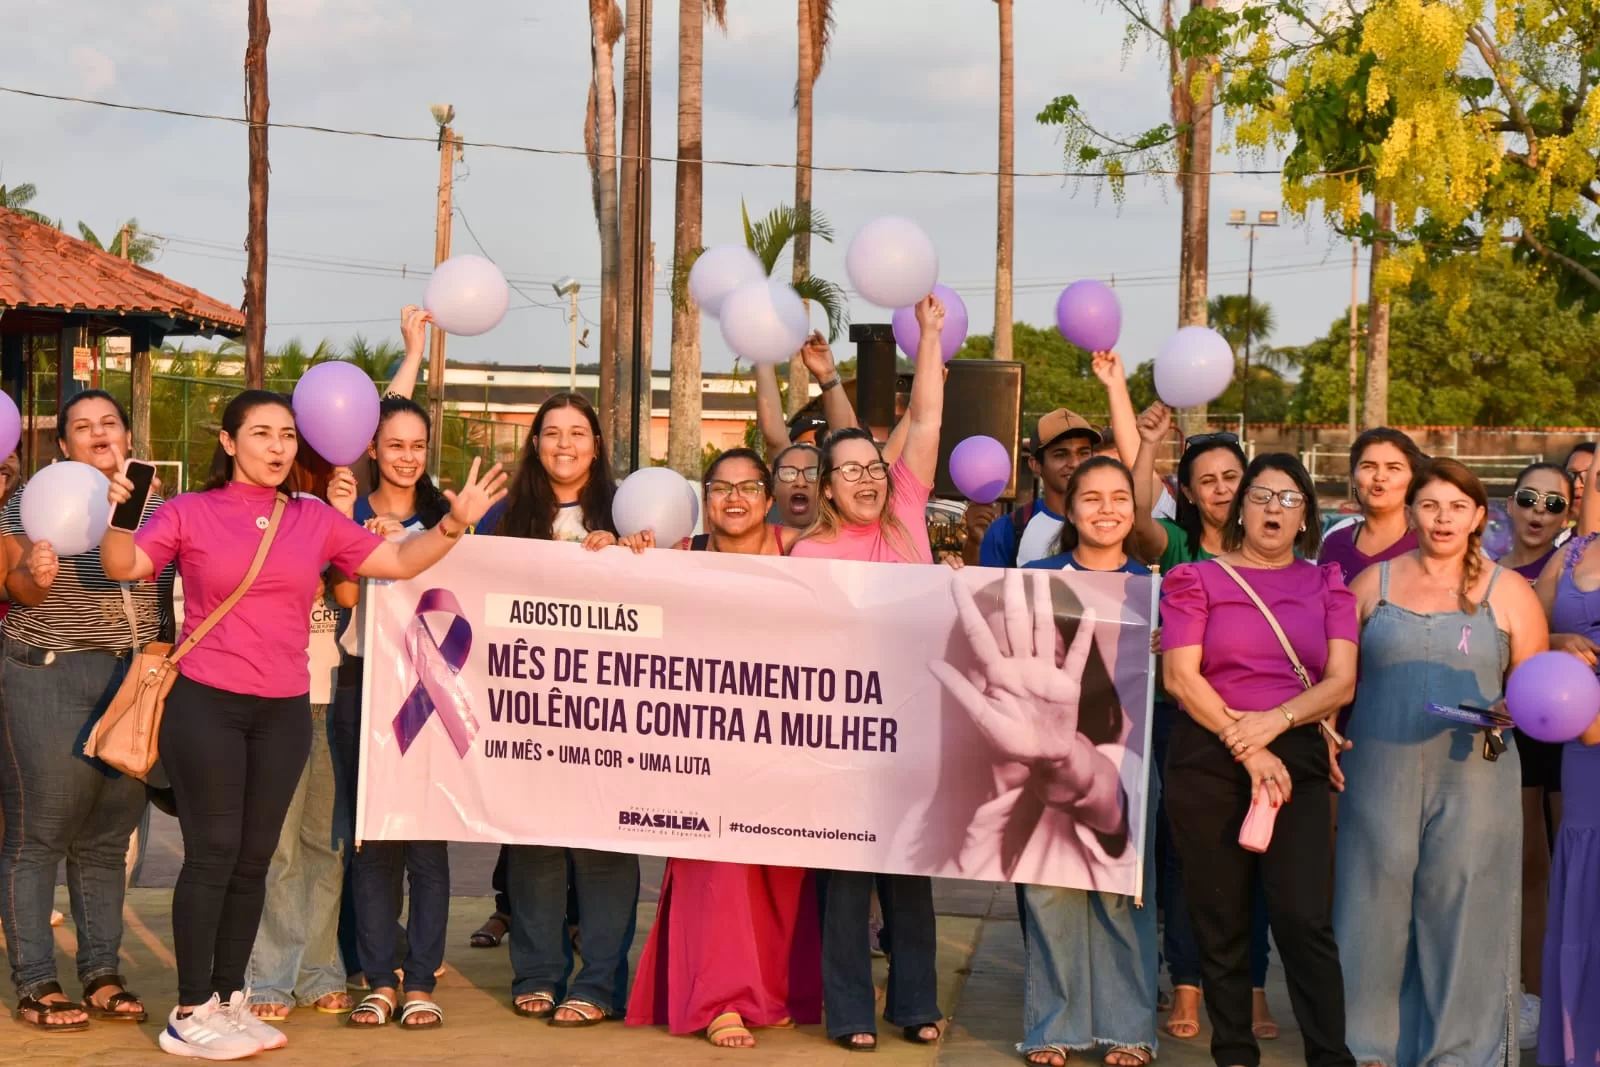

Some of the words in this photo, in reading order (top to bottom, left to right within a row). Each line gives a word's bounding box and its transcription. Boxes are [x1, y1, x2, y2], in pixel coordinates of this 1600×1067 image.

[510, 600, 582, 628] AGOSTO
[588, 603, 639, 632] LILÁS
[488, 637, 546, 680] MÊS
[554, 648, 589, 684] DE
[597, 651, 836, 703] ENFRENTAMENTO
[845, 670, 883, 705] DA
[488, 686, 628, 733] VIOLÊNCIA
[636, 701, 746, 743] CONTRA
[754, 709, 773, 745] A
[781, 712, 898, 753] MULHER
[485, 740, 508, 759] UM
[512, 737, 543, 762] MÊS
[559, 745, 591, 766] UMA
[595, 748, 623, 769] COR
[640, 753, 672, 773] UMA
[676, 755, 711, 777] LUTA
[619, 811, 710, 832] BRASILEIA
[729, 821, 877, 842] #todoscontaviolencia
